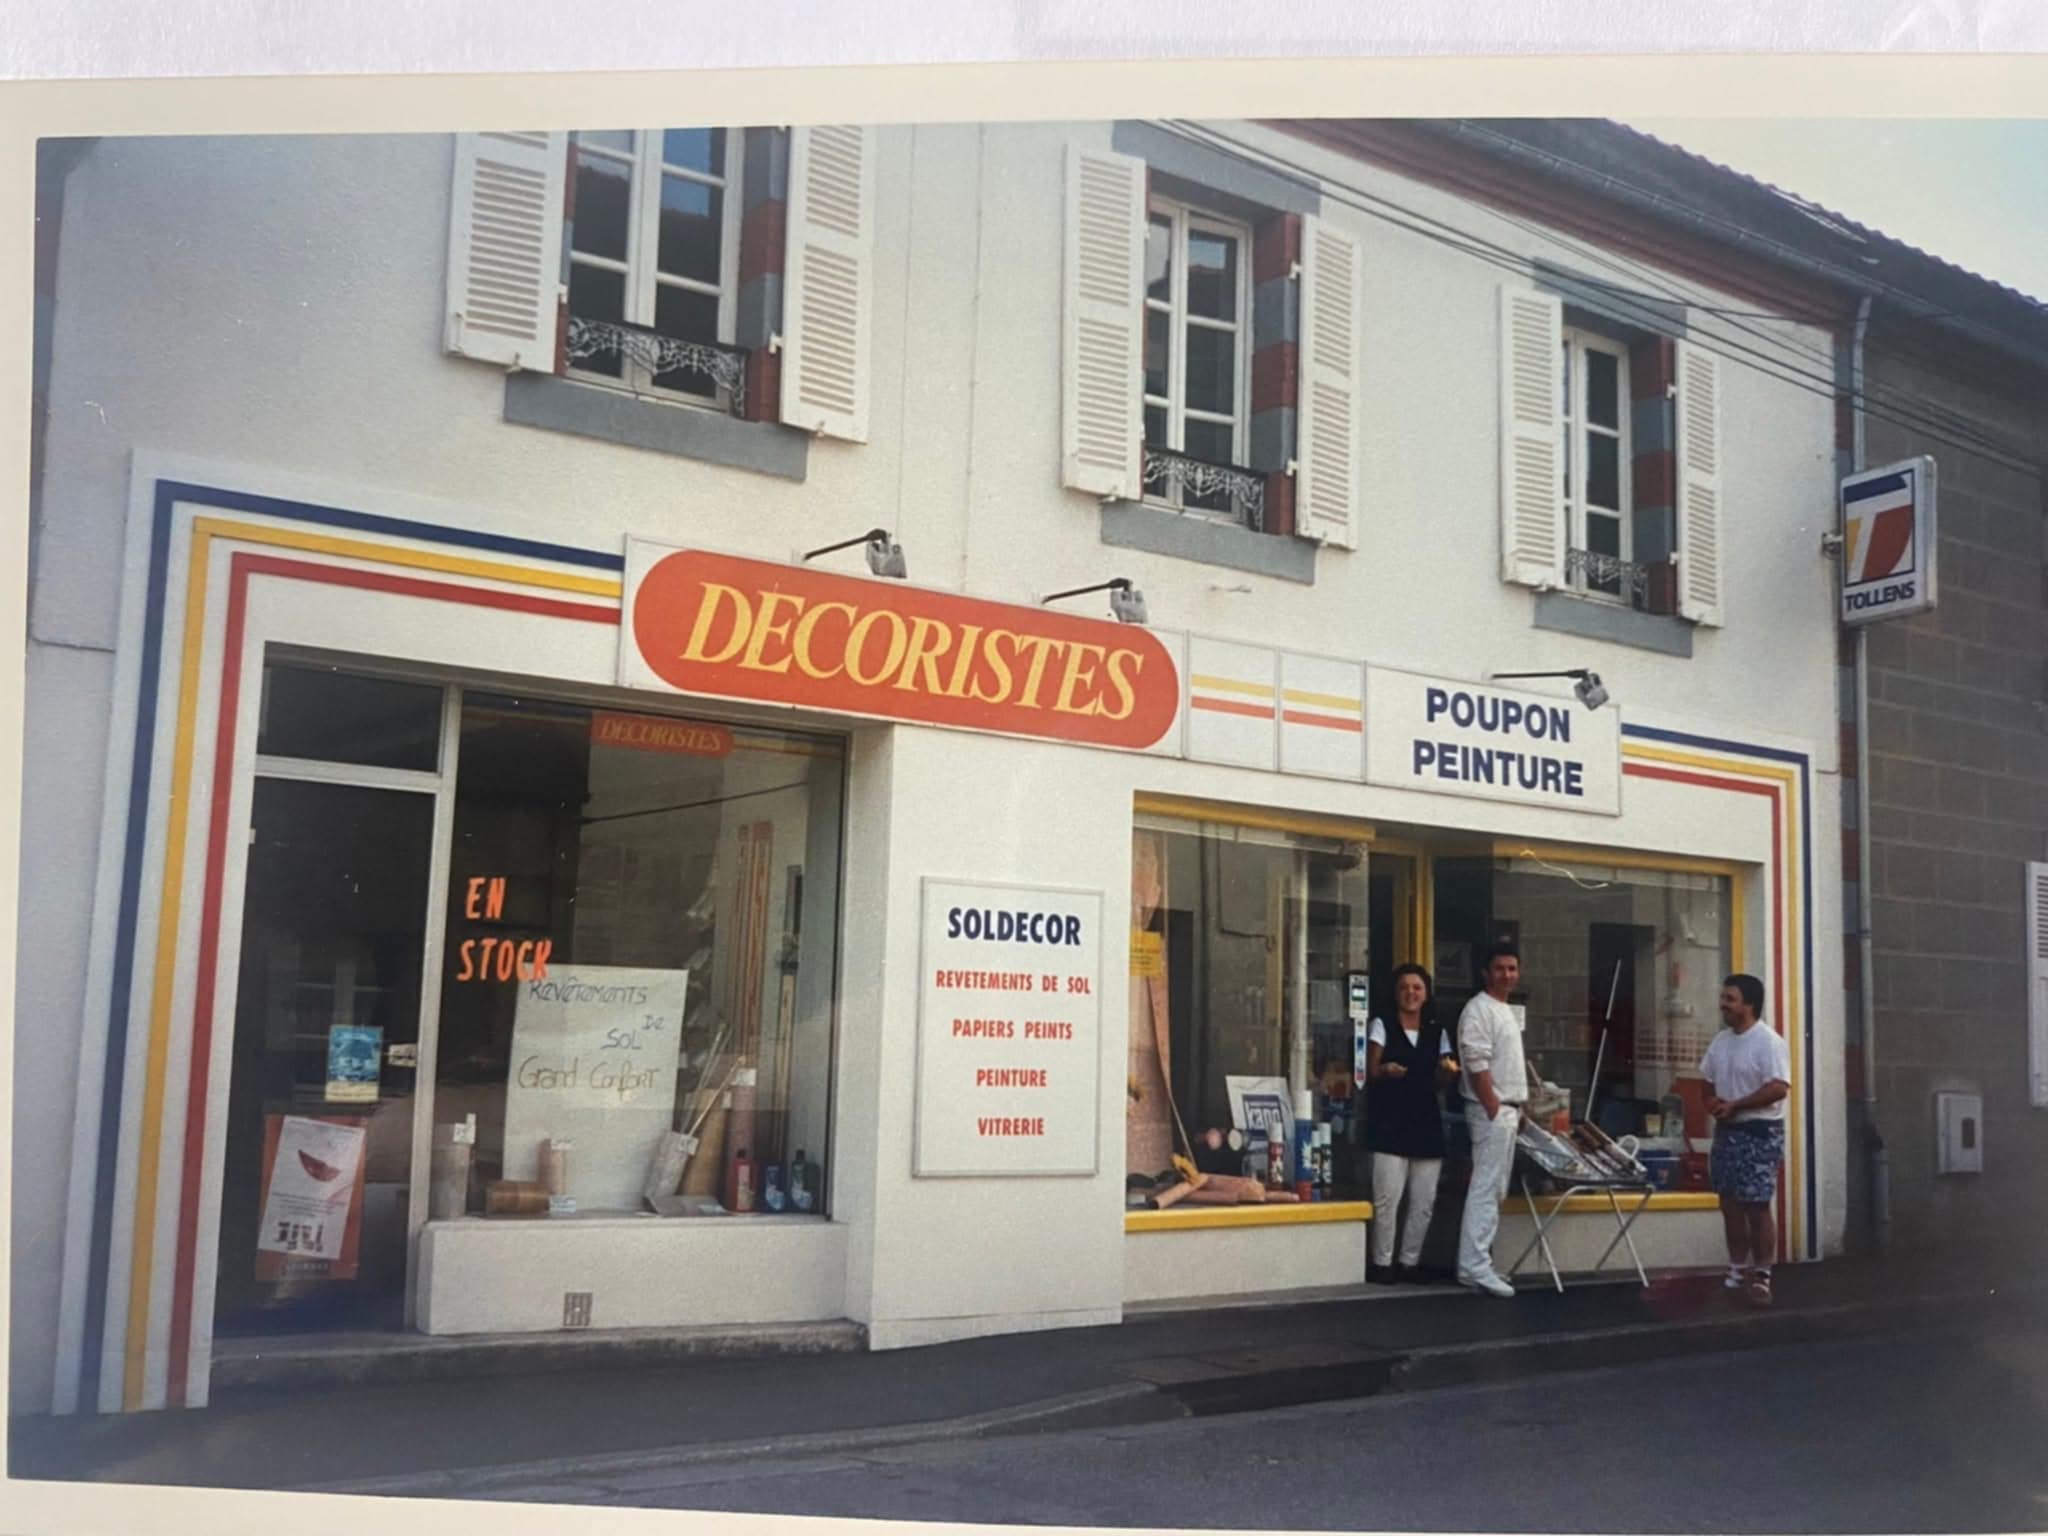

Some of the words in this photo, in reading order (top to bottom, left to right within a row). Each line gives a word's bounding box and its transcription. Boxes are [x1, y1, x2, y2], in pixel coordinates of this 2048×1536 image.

[1844, 581, 1916, 612] TOLLENS
[1426, 687, 1571, 744] POUPON
[1413, 739, 1584, 797] PEINTURE
[465, 877, 507, 920] EN
[947, 907, 1081, 946] SOLDECOR
[456, 938, 553, 982] STOCK
[935, 969, 1033, 992] REVETEMENTS
[1041, 975, 1059, 993] DE
[1067, 976, 1091, 995] SOL
[952, 1019, 1014, 1039] PAPIERS
[1024, 1022, 1073, 1041] PEINTS
[976, 1068, 1048, 1088] PEINTURE
[977, 1117, 1045, 1137] VITRERIE
